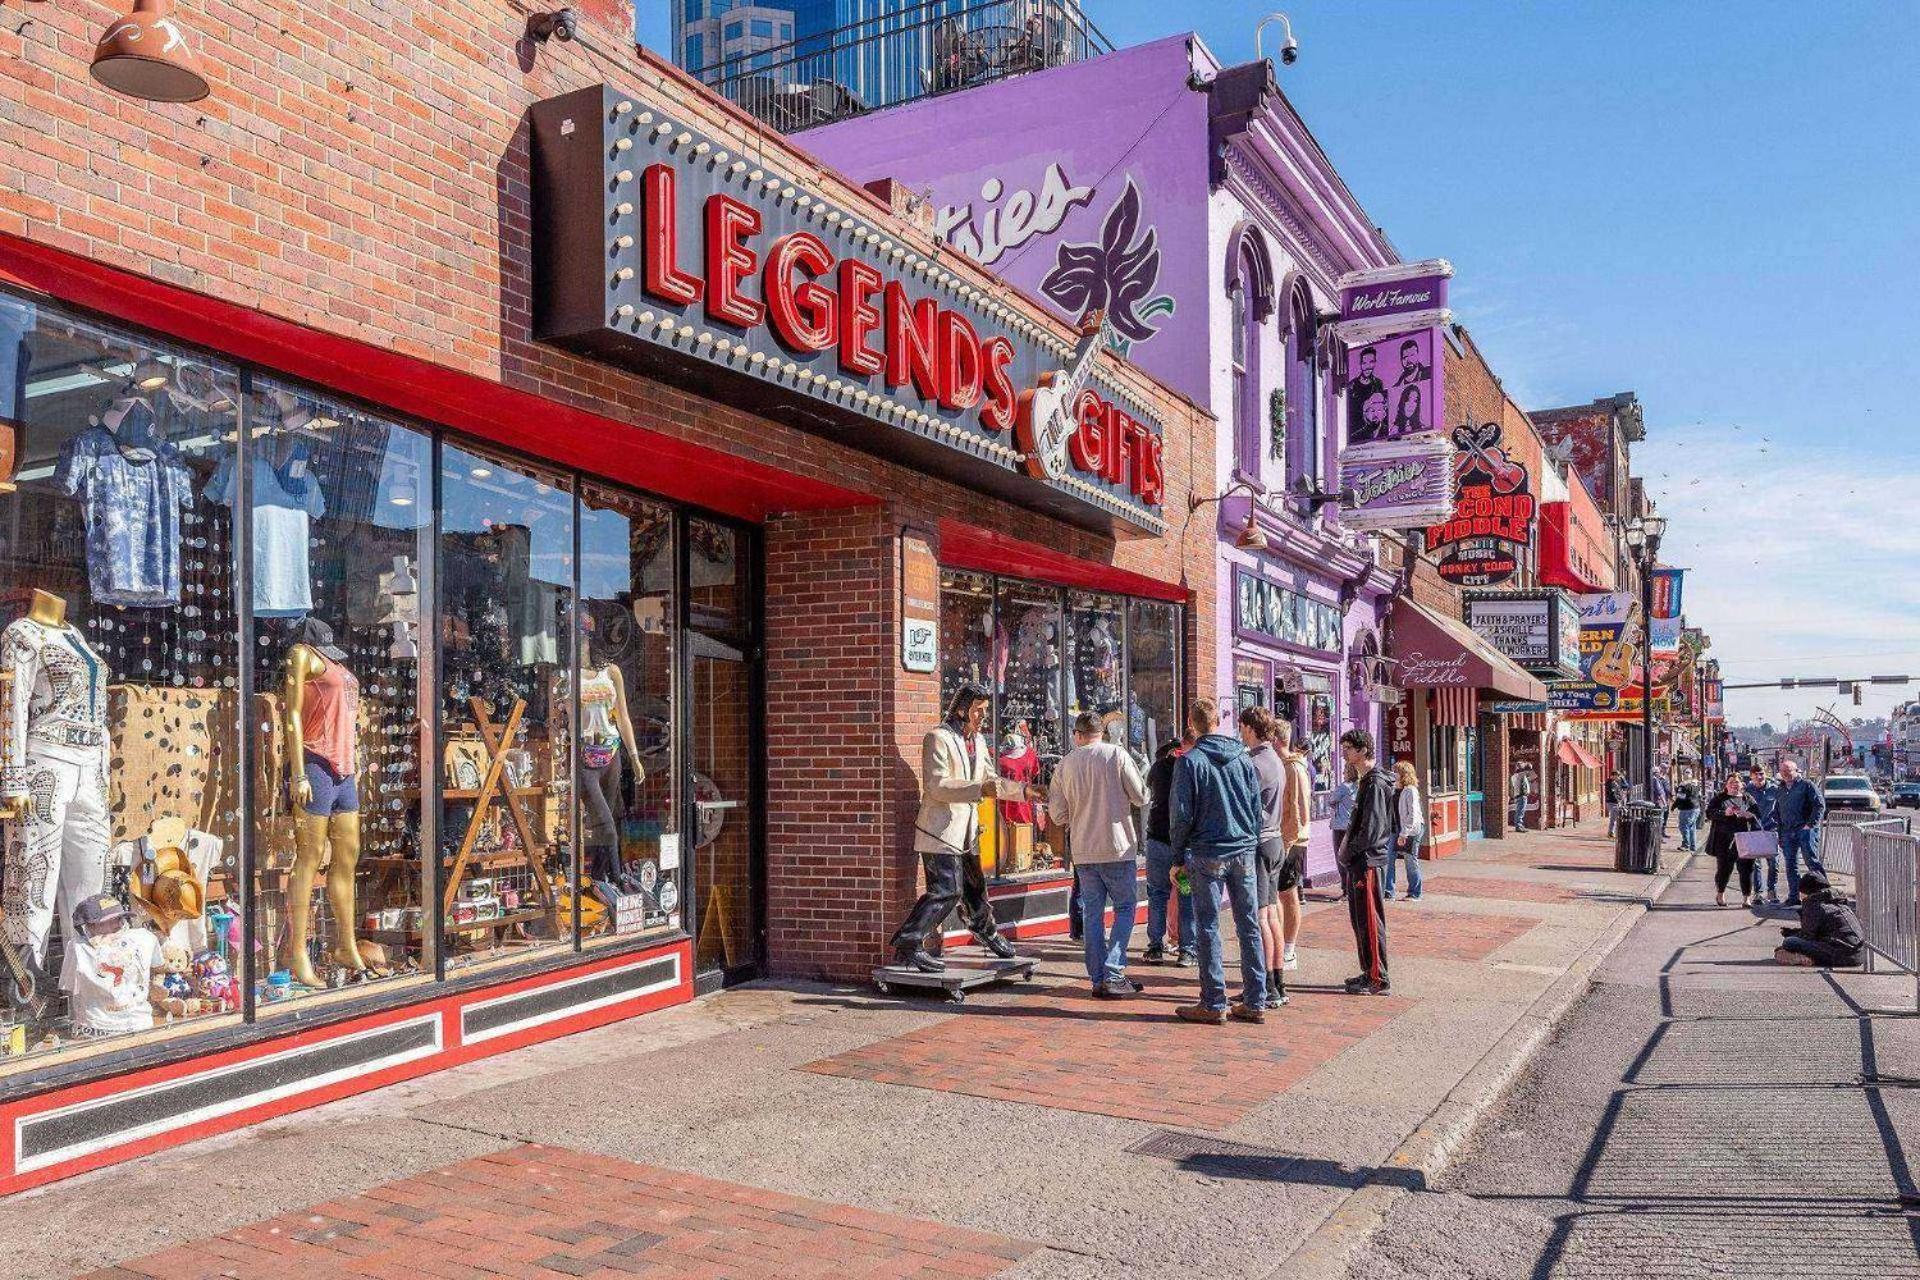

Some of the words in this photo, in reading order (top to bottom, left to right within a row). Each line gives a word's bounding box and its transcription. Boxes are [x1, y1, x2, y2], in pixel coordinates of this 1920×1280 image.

[642, 162, 1016, 431] LEGENDS
[1352, 292, 1388, 312] World
[1386, 289, 1431, 306] Famous
[1068, 388, 1163, 505] GIFTS
[1462, 485, 1491, 499] THE
[1456, 495, 1533, 518] COND
[1427, 516, 1528, 550] FIDDLE
[1458, 549, 1496, 560] MUSIC
[1440, 563, 1478, 574] HONKY
[1462, 575, 1490, 585] CITY
[1475, 615, 1501, 625] FAITH
[1509, 615, 1548, 625] PRAYERS
[1493, 635, 1528, 645] THANKS
[1579, 641, 1604, 652] LD
[1402, 652, 1467, 668] Second
[1401, 666, 1469, 685] Fiddle
[1392, 740, 1412, 752] BAR
